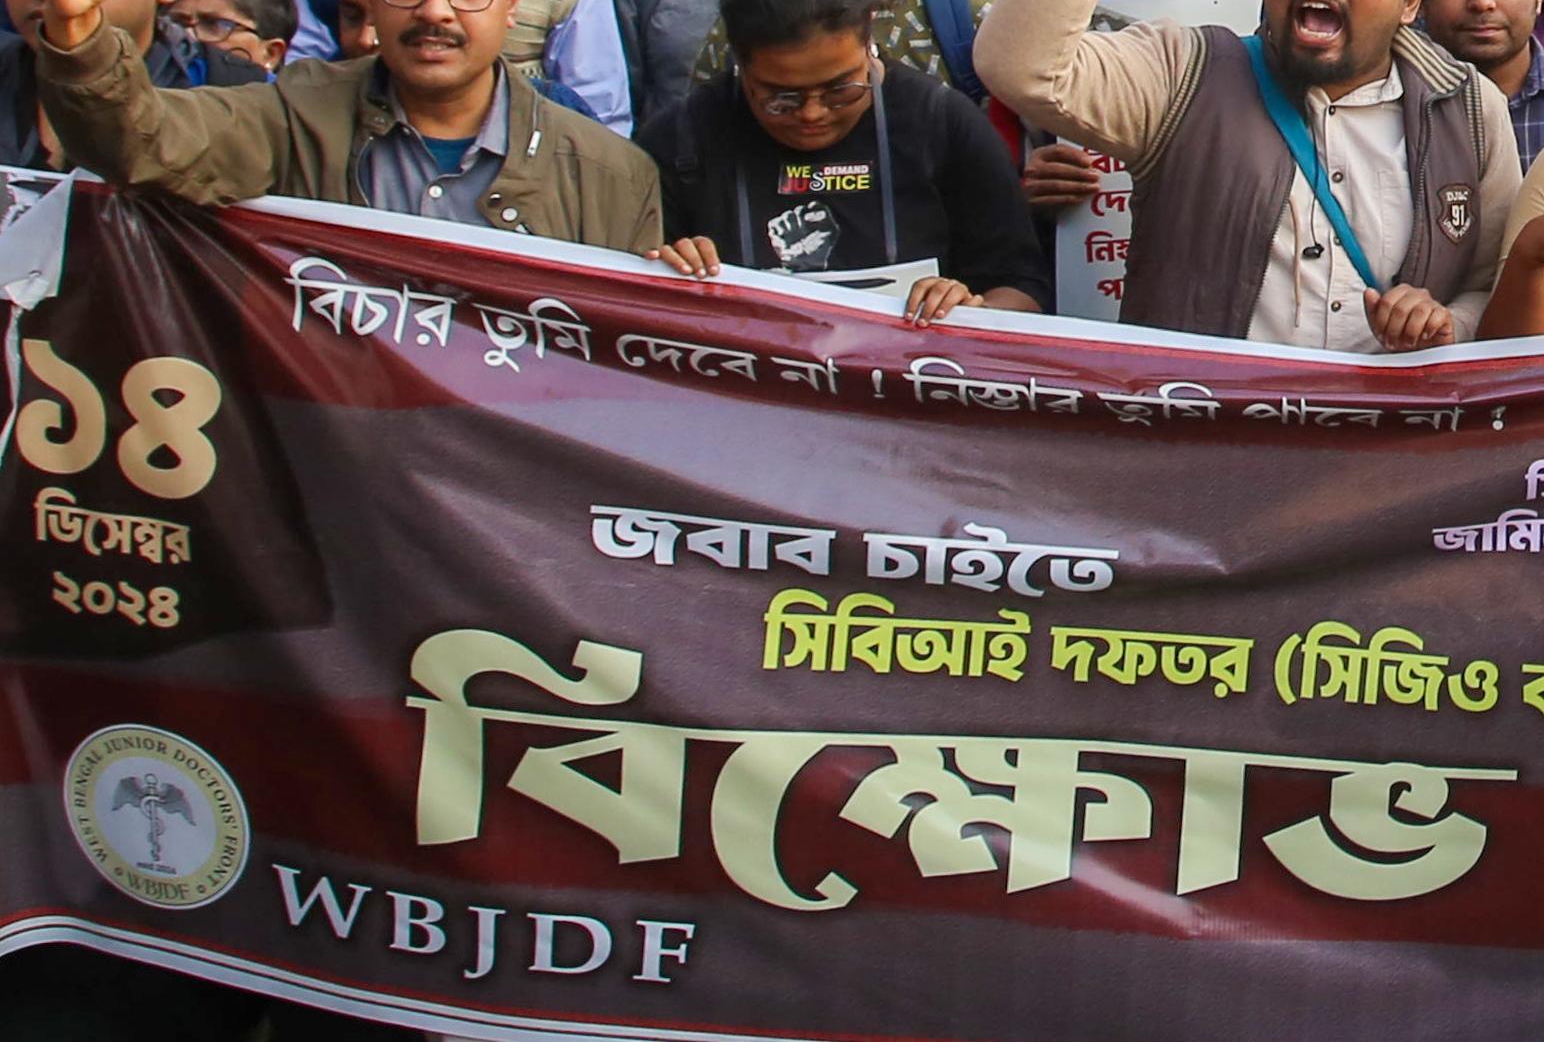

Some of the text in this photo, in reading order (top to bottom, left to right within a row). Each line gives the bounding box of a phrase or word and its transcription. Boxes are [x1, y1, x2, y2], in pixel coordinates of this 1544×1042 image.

[783, 172, 871, 192] JUSTICE
[786, 164, 869, 178] WE DEMAND
[1451, 204, 1465, 226] 91
[286, 257, 455, 348] বিচার
[479, 298, 591, 372] তুমি
[616, 334, 757, 382] দেবে
[771, 356, 841, 395] না
[903, 356, 1083, 414] নিস্তার
[1097, 382, 1221, 427] তুমি
[1243, 397, 1384, 429] পাবে
[1400, 405, 1466, 432] না
[15, 338, 223, 500] ১৪
[34, 487, 190, 565] ডিসেম্বর
[590, 504, 1121, 598] জবাব চাইতে
[52, 571, 180, 629] ২০২৪
[763, 587, 1032, 683] সিবিআই
[1050, 625, 1255, 700] দফতর
[1273, 618, 1500, 715] (সিজিও
[105, 736, 168, 755] JUNIOR
[206, 834, 239, 888] FRONT
[406, 628, 1518, 912] বিক্ষোভ
[127, 871, 189, 901] WBJDF
[271, 863, 696, 982] WBJDF
